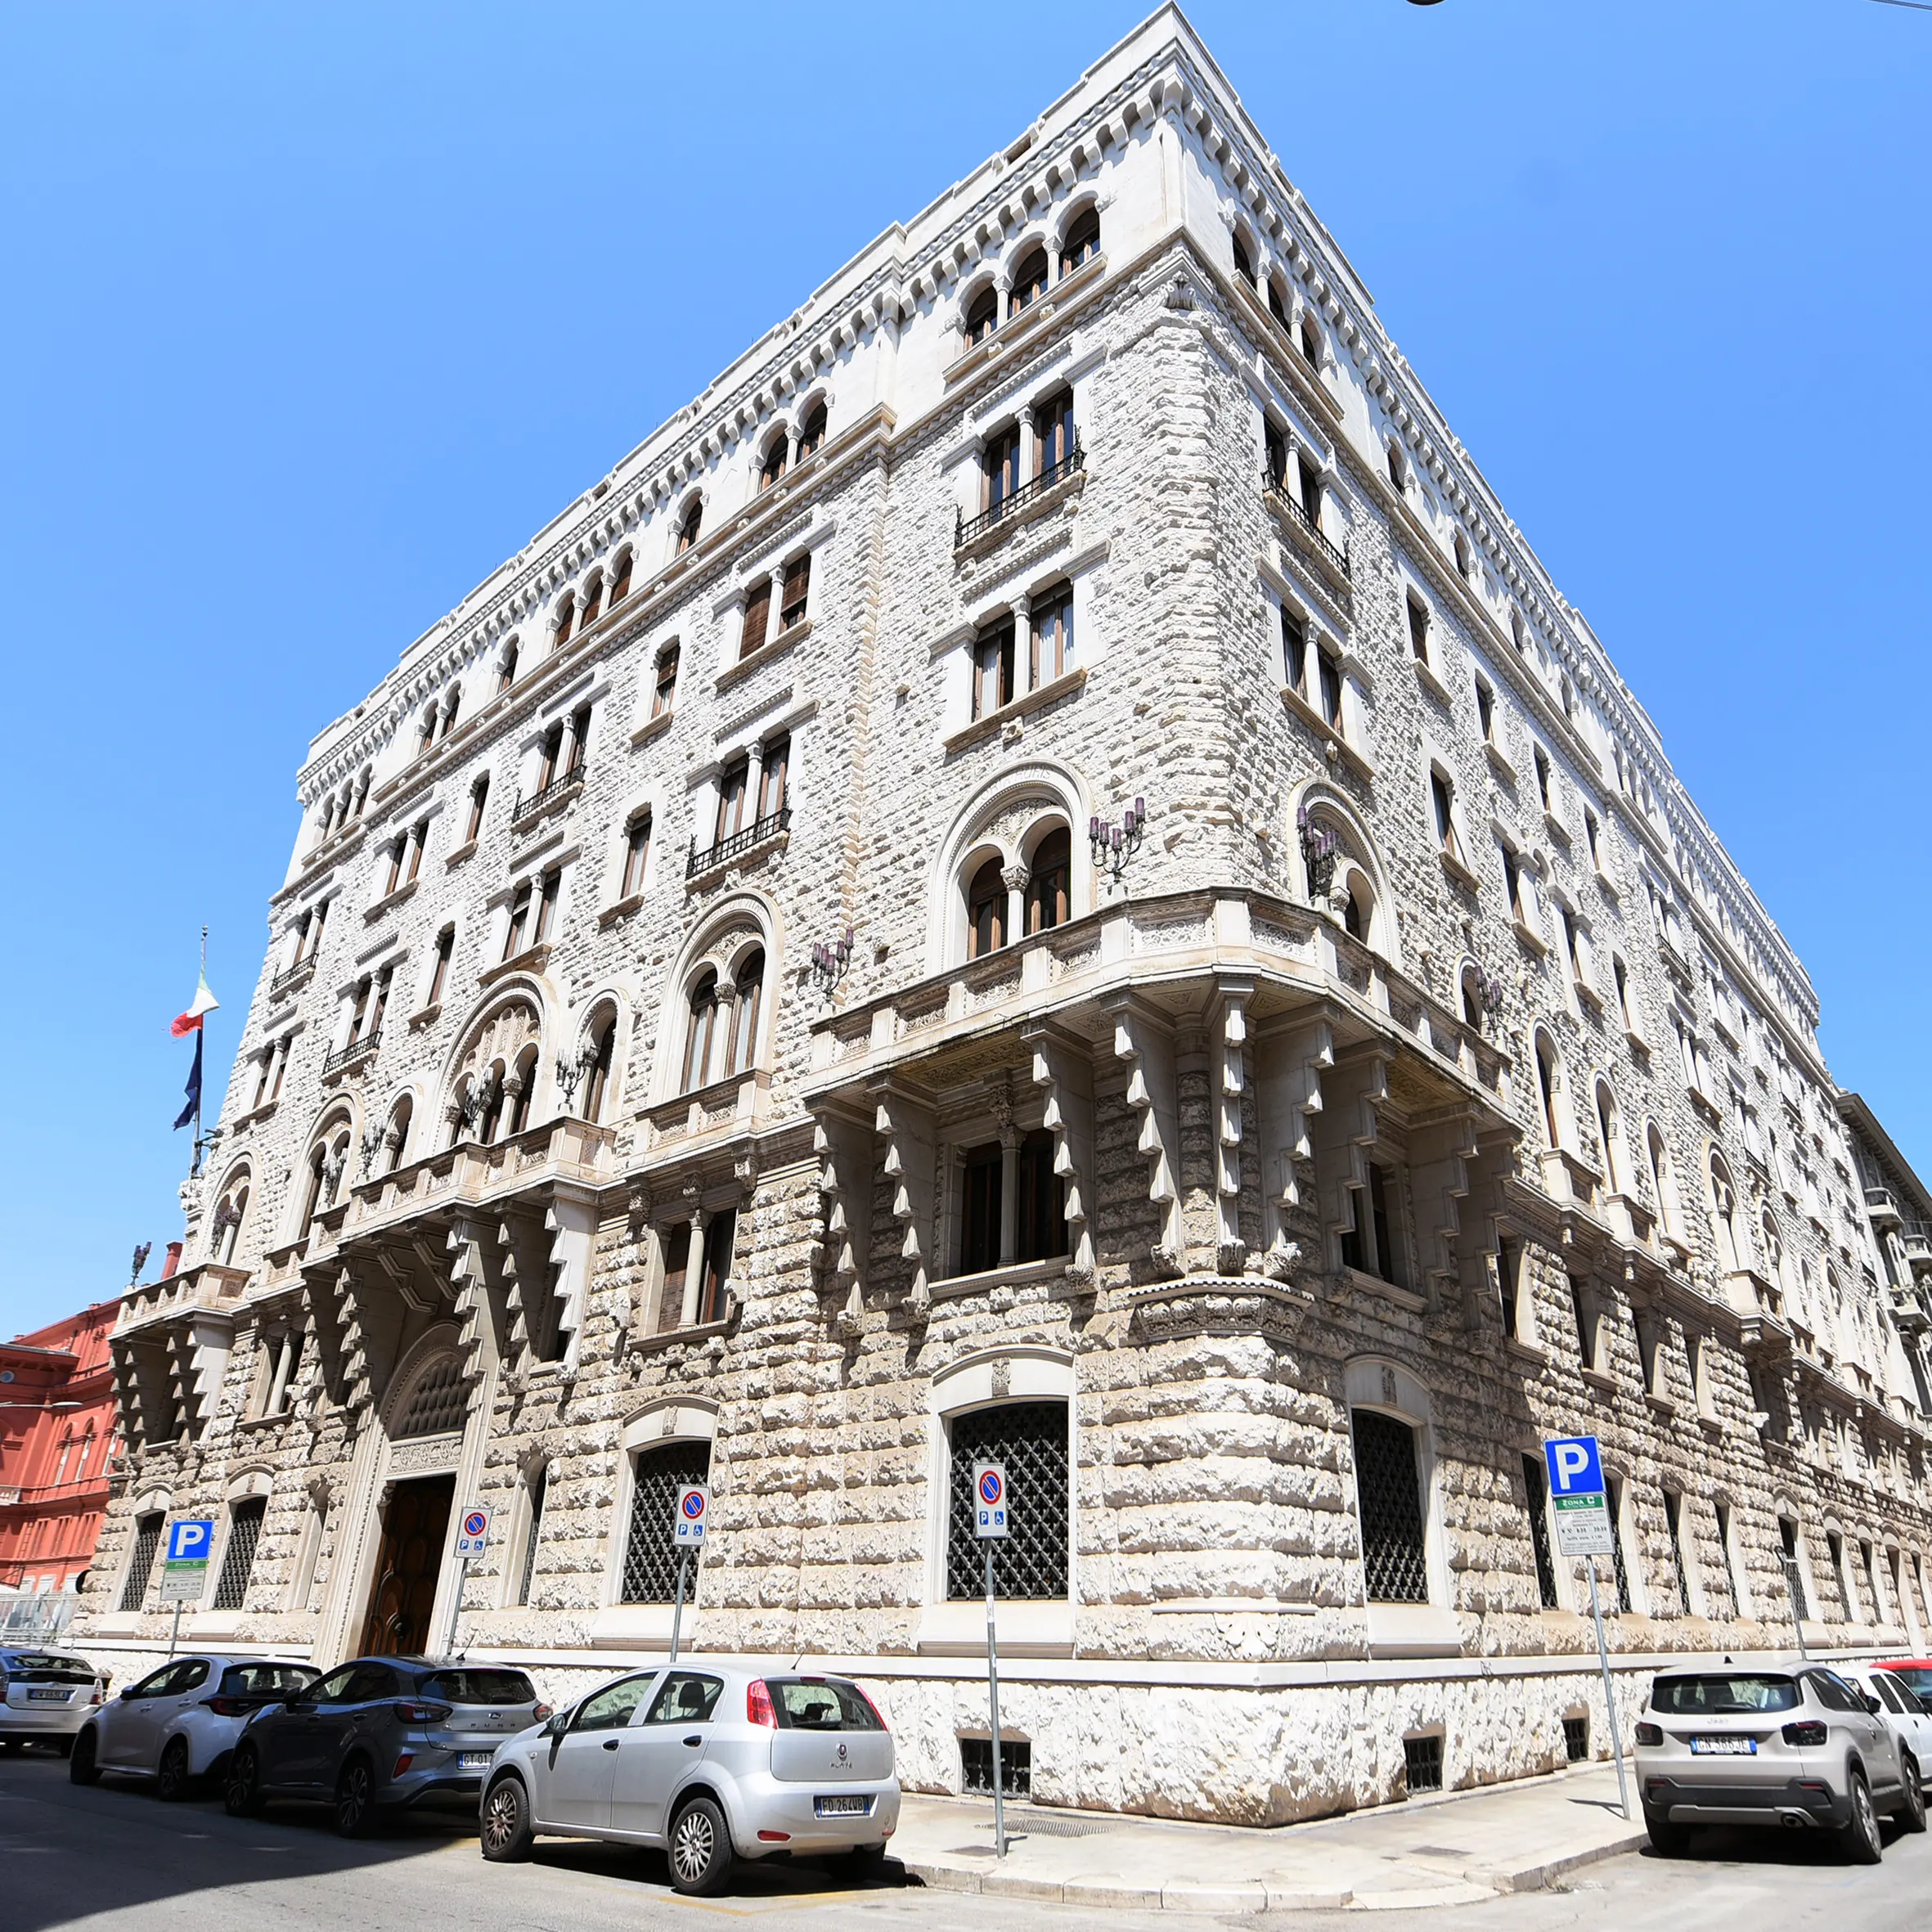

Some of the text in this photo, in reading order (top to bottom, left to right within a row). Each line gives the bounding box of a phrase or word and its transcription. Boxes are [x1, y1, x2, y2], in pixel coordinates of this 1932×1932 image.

[1555, 1443, 1589, 1490] P
[1562, 1498, 1584, 1507] ZONA
[981, 1512, 987, 1525] P
[680, 1525, 686, 1535] P
[175, 1524, 204, 1557] P
[461, 1540, 468, 1549] P
[464, 1754, 474, 1765] GT
[822, 1798, 863, 1813] FD 264WB
